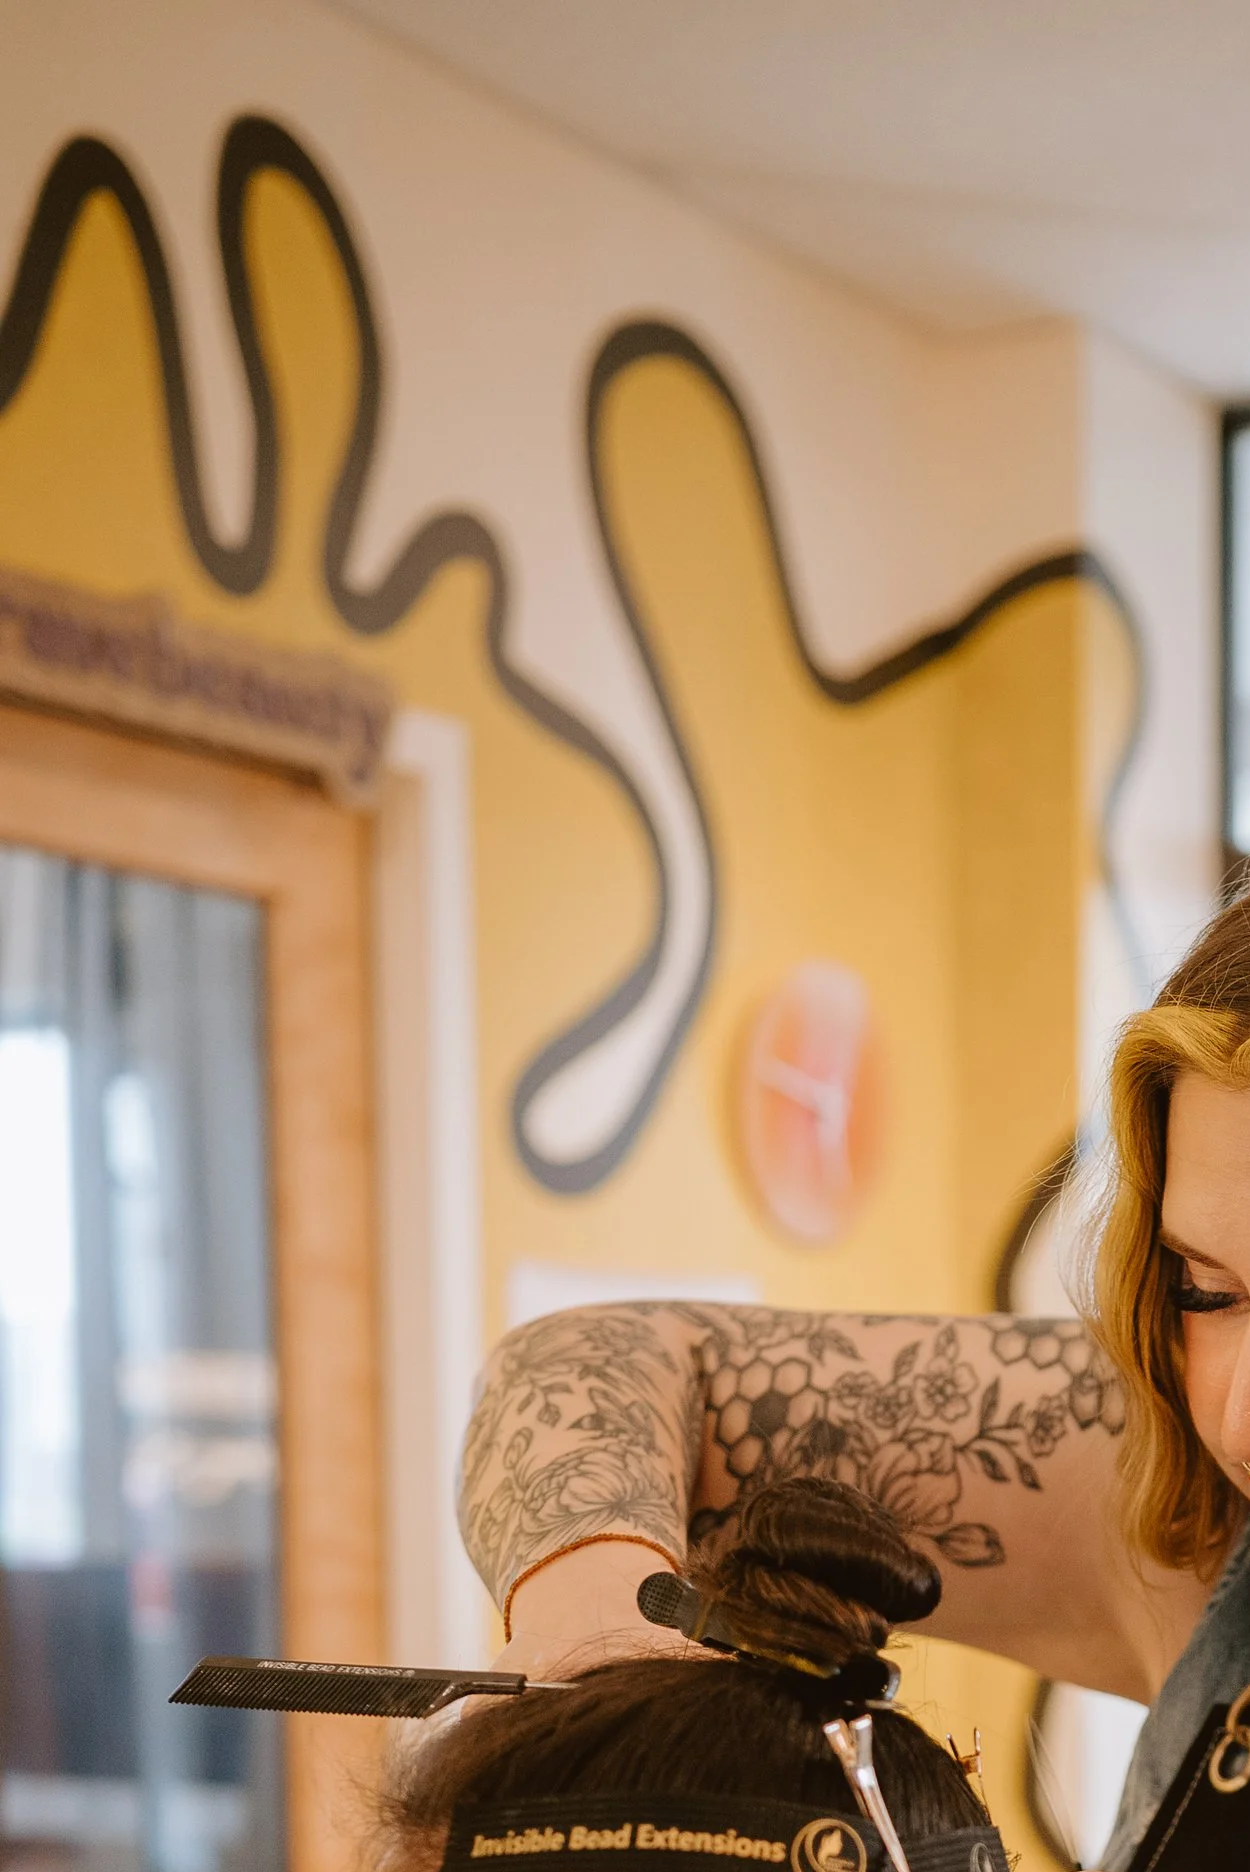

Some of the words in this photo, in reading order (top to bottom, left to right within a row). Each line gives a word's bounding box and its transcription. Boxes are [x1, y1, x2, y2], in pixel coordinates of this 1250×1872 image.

[256, 1660, 306, 1671] INVISIBLE
[306, 1663, 336, 1672] BEAD
[336, 1665, 402, 1676] EXTENSIONS
[471, 1827, 565, 1858] Invisible
[568, 1823, 633, 1850] Bead
[635, 1823, 787, 1863] Extensions
